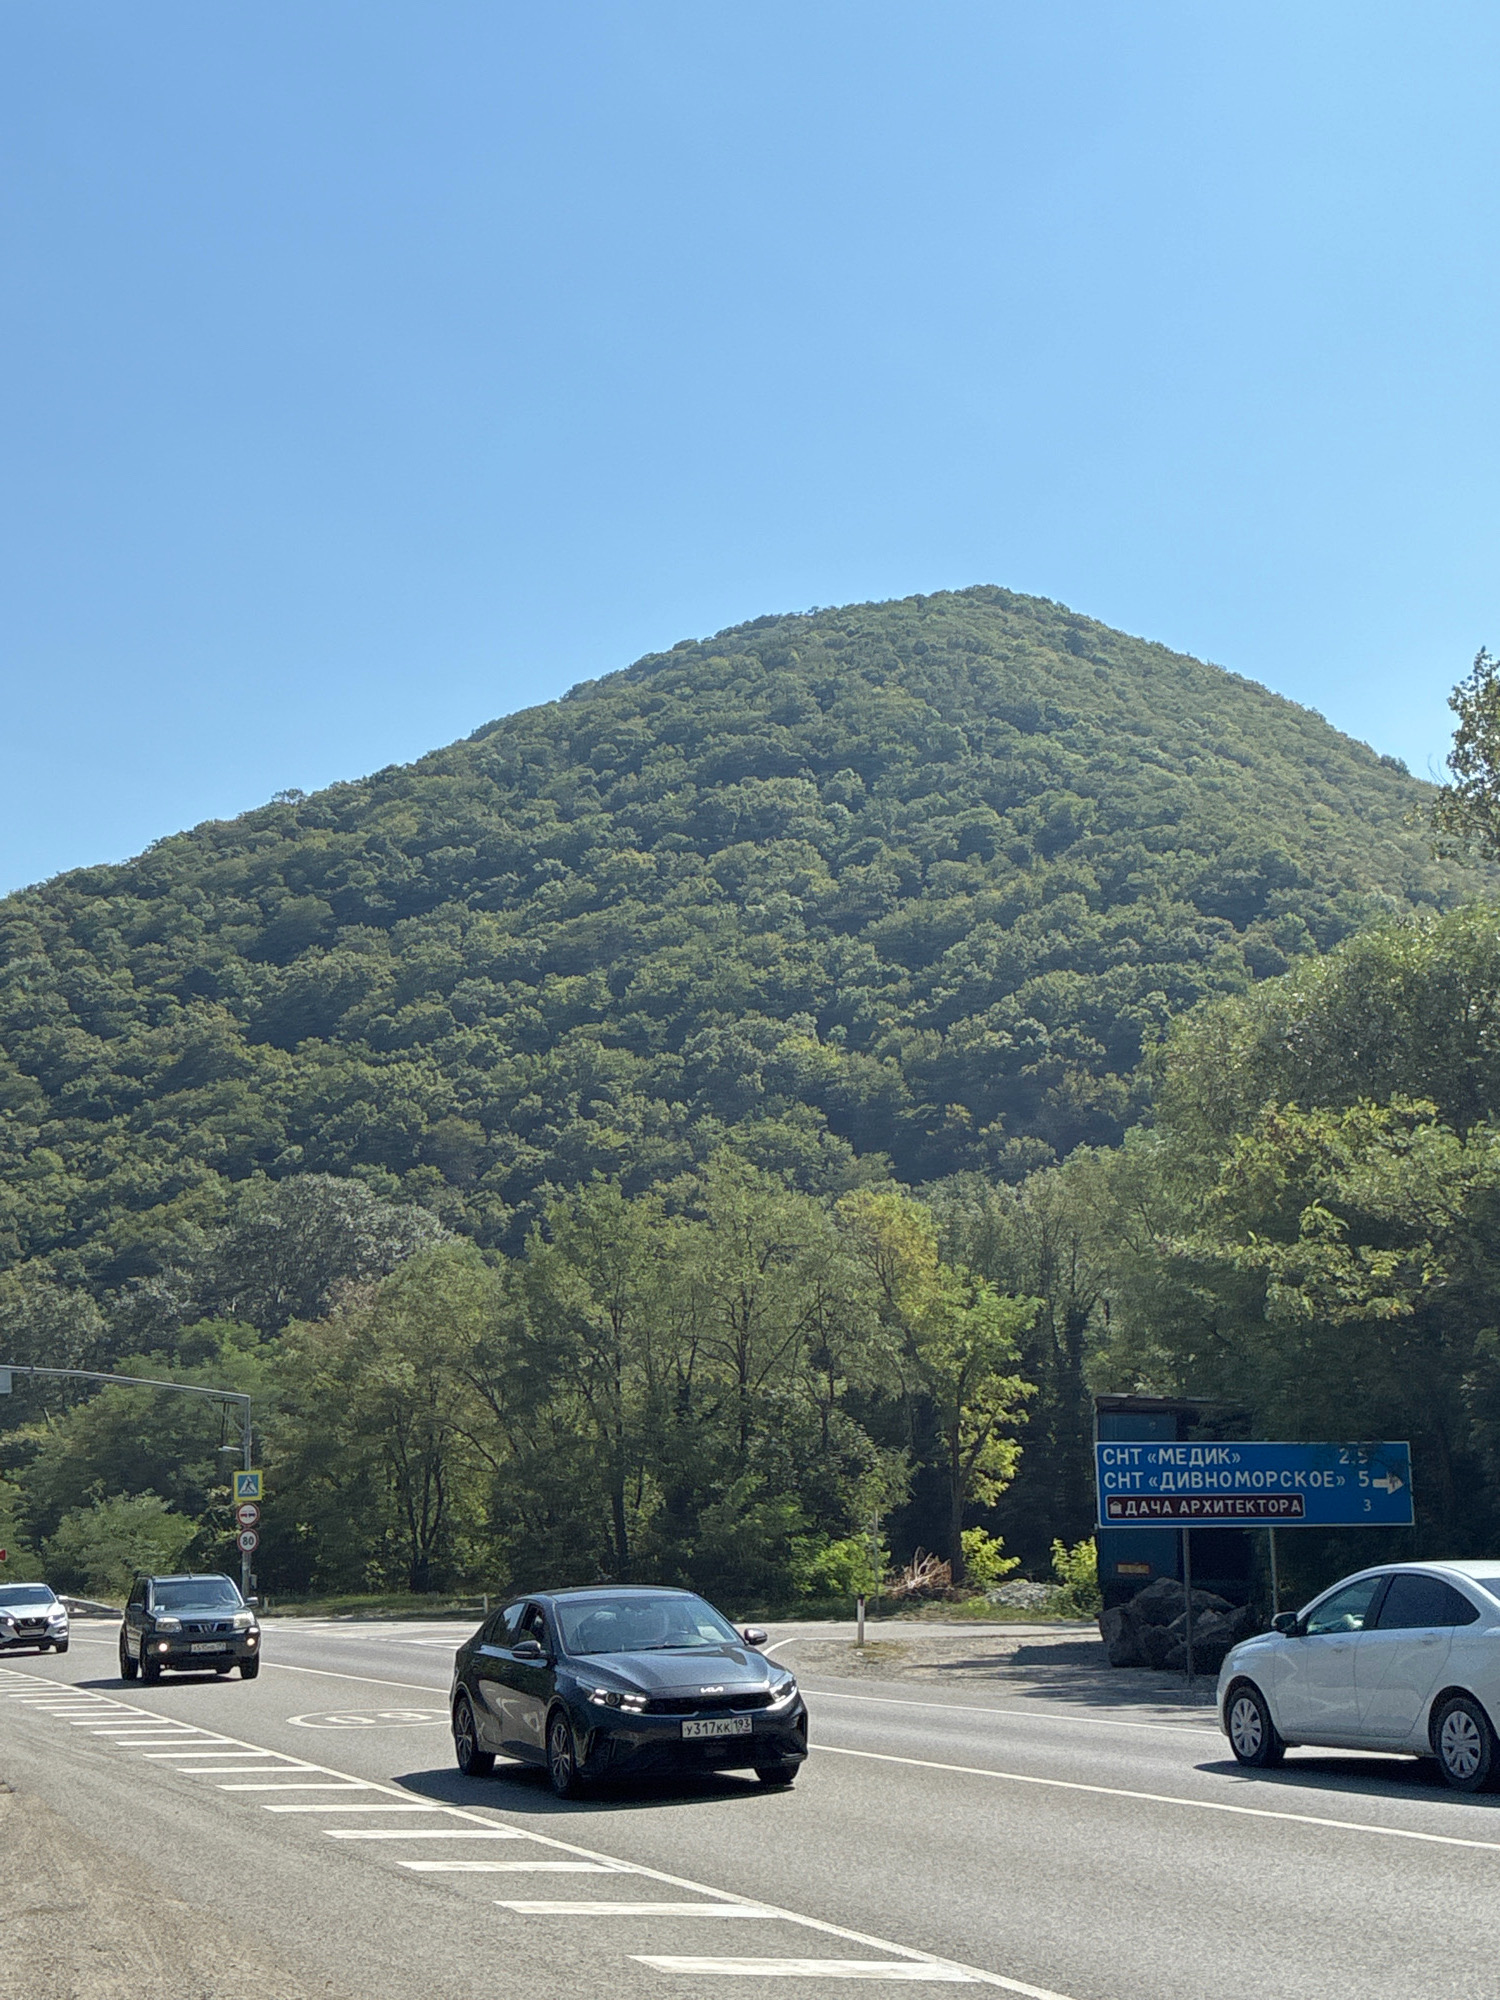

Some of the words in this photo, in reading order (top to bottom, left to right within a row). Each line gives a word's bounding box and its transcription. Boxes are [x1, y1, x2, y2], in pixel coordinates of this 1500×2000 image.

[1102, 1448, 1142, 1465] СНТ
[1147, 1447, 1241, 1468] «МЕДИК»
[1103, 1471, 1144, 1489] СНТ
[1148, 1470, 1346, 1491] «ДИВНОМОРСКОЕ»
[1358, 1470, 1370, 1487] 5
[1125, 1500, 1173, 1516] ДАЧА
[1179, 1499, 1302, 1514] АРХИТЕКТОРА
[1363, 1498, 1372, 1512] 3
[242, 1535, 255, 1546] 80
